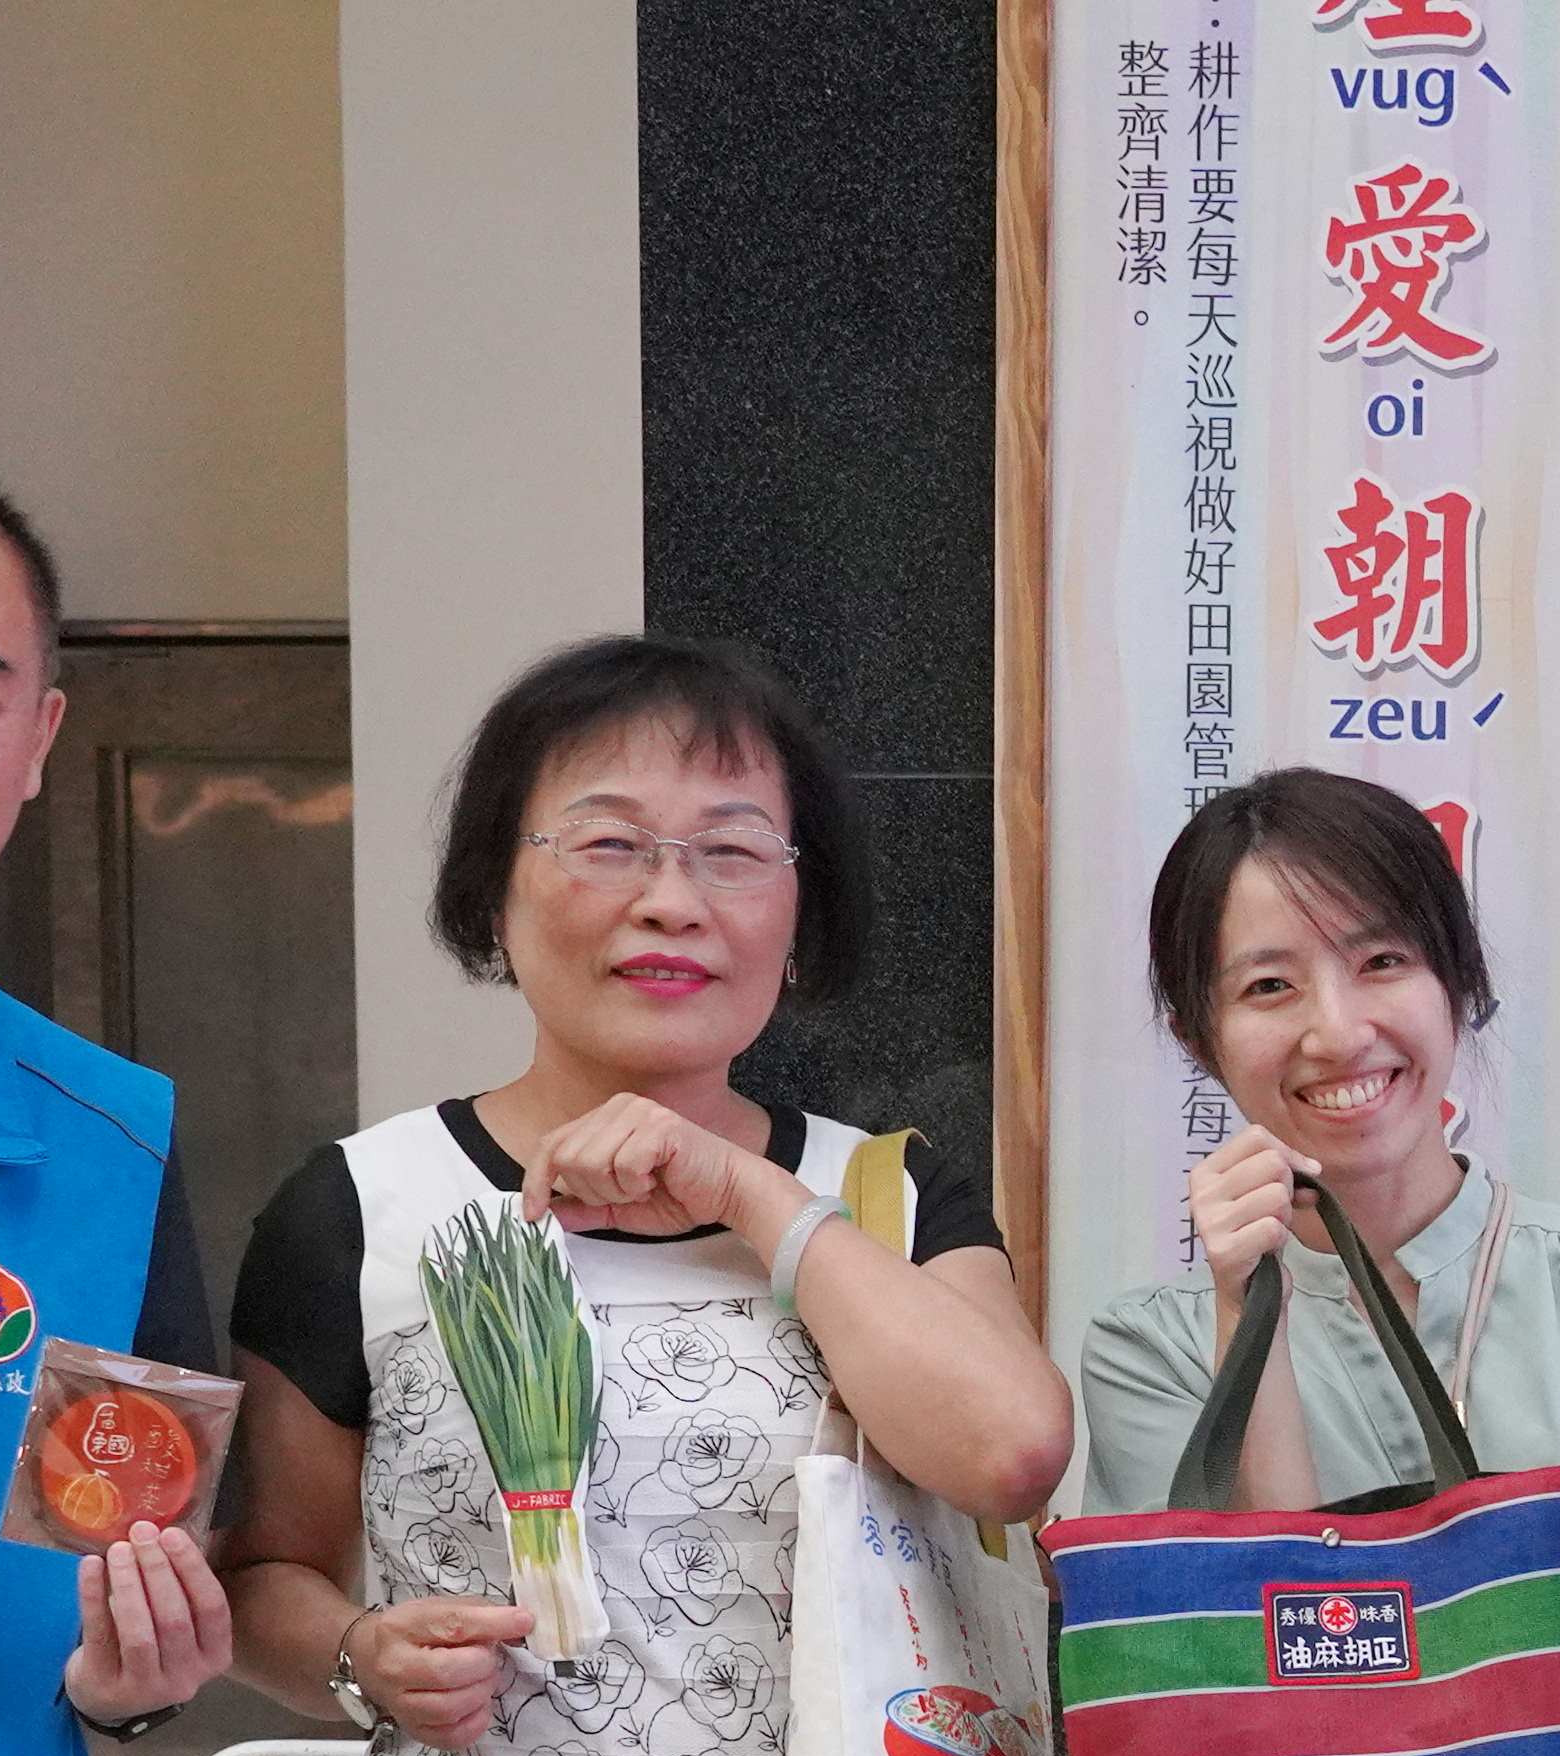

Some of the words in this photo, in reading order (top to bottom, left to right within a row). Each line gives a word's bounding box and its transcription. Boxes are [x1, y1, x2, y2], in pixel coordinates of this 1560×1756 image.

[1325, 163, 1484, 362] 愛
[1366, 379, 1427, 439] oi
[1315, 478, 1476, 671] 朝
